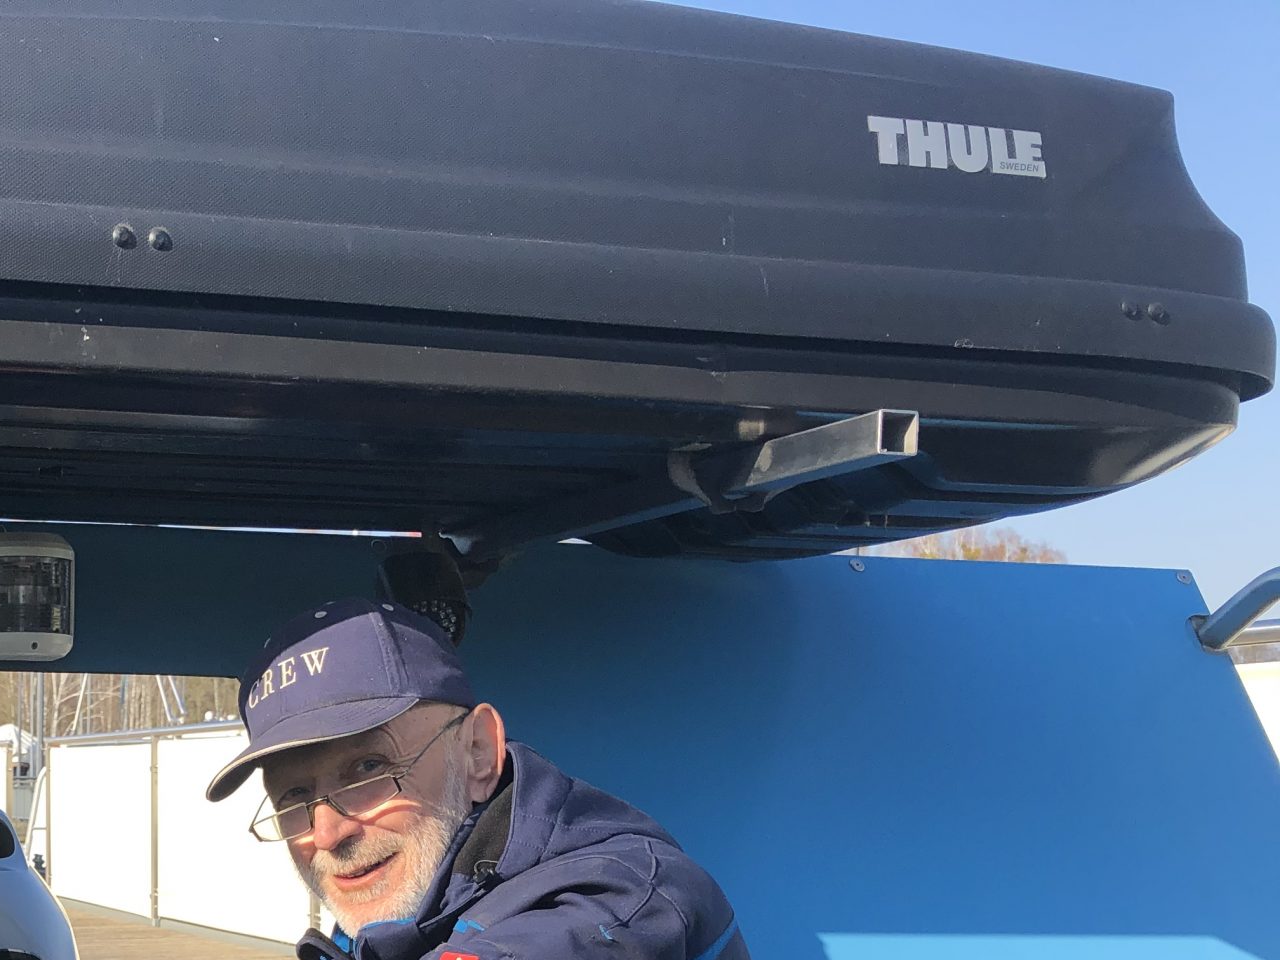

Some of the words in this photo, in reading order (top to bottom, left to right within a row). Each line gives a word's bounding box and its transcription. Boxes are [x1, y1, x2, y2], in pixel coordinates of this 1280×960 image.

[867, 115, 1047, 178] THULE
[999, 161, 1040, 173] SWEDEN
[248, 647, 329, 709] CREW
